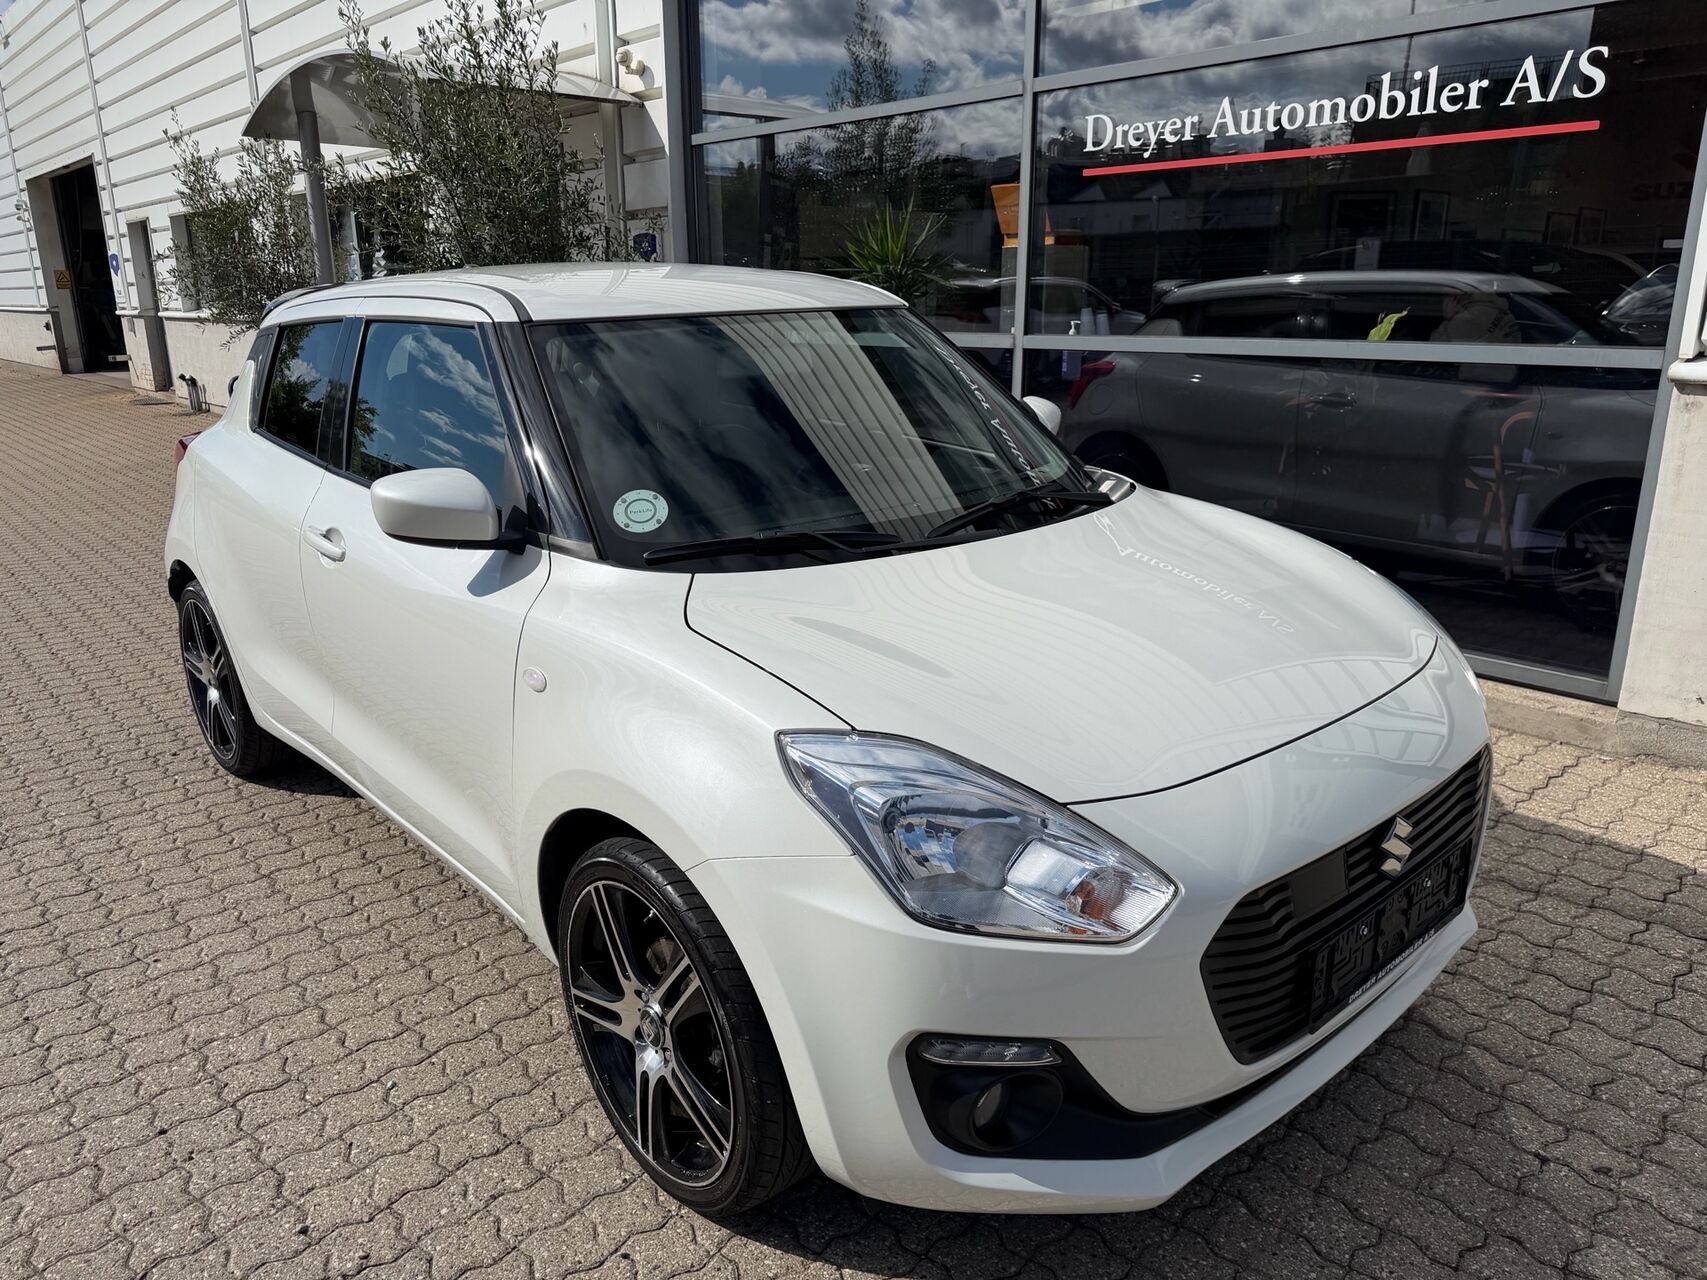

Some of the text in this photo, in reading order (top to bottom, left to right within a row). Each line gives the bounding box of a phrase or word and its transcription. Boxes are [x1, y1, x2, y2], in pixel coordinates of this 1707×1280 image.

[1083, 45, 1609, 159] Dreyer Automobiler A/S
